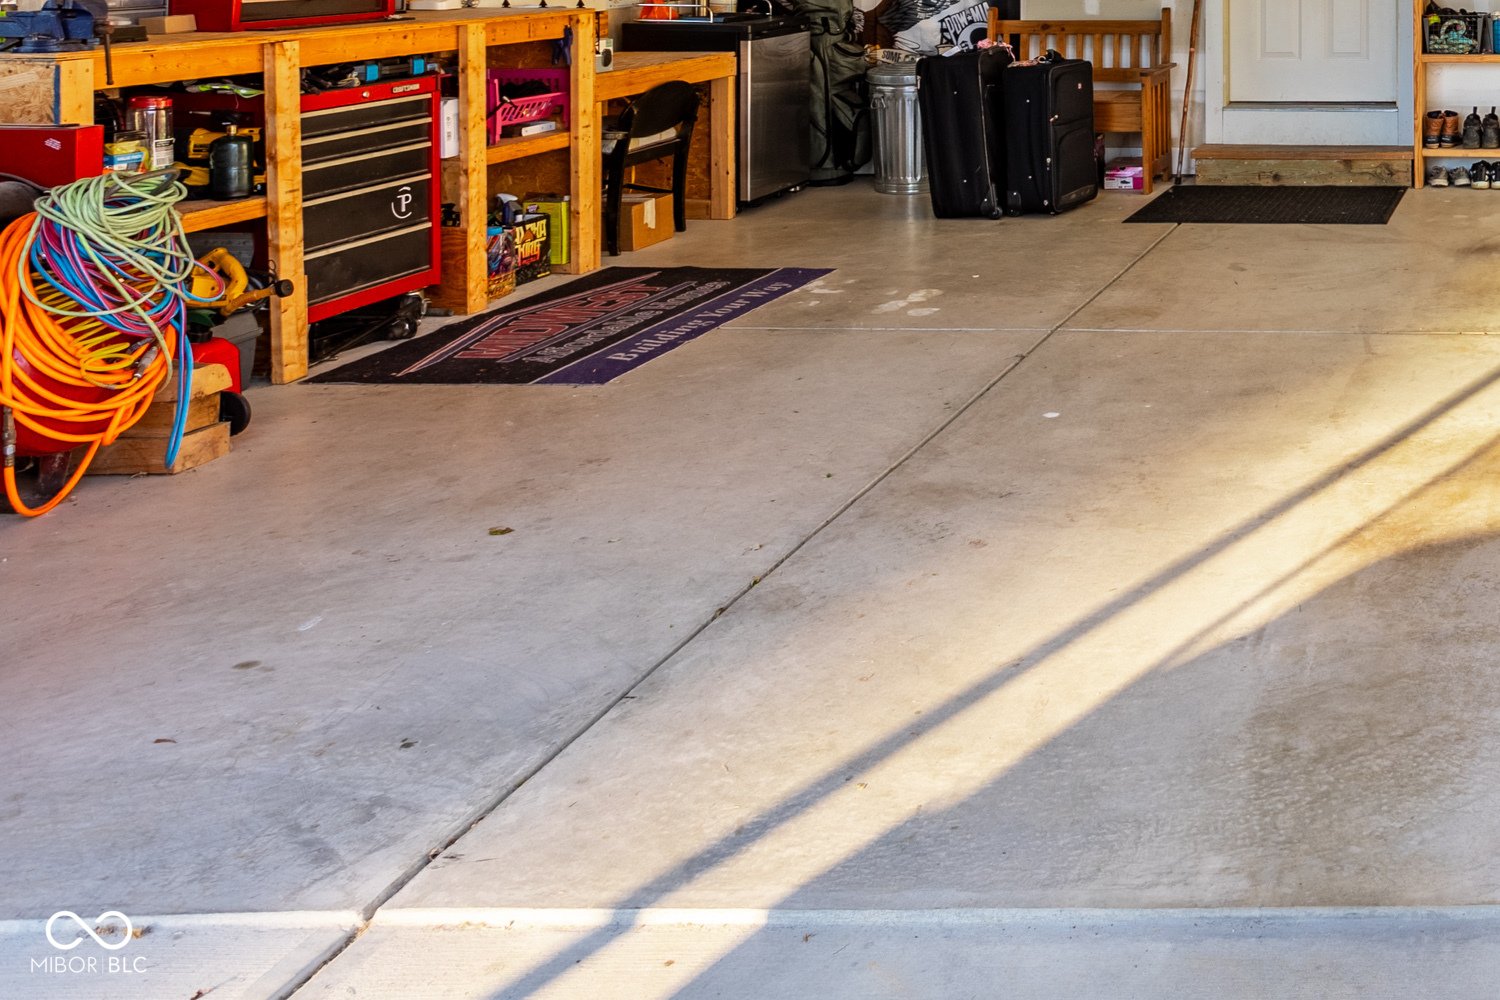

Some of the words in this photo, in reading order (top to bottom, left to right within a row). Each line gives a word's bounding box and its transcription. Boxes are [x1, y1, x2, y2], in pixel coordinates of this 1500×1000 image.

[945, 10, 969, 46] POW
[881, 49, 902, 63] SOME
[606, 317, 715, 362] Building
[696, 298, 751, 318] Your
[742, 281, 793, 298] Way
